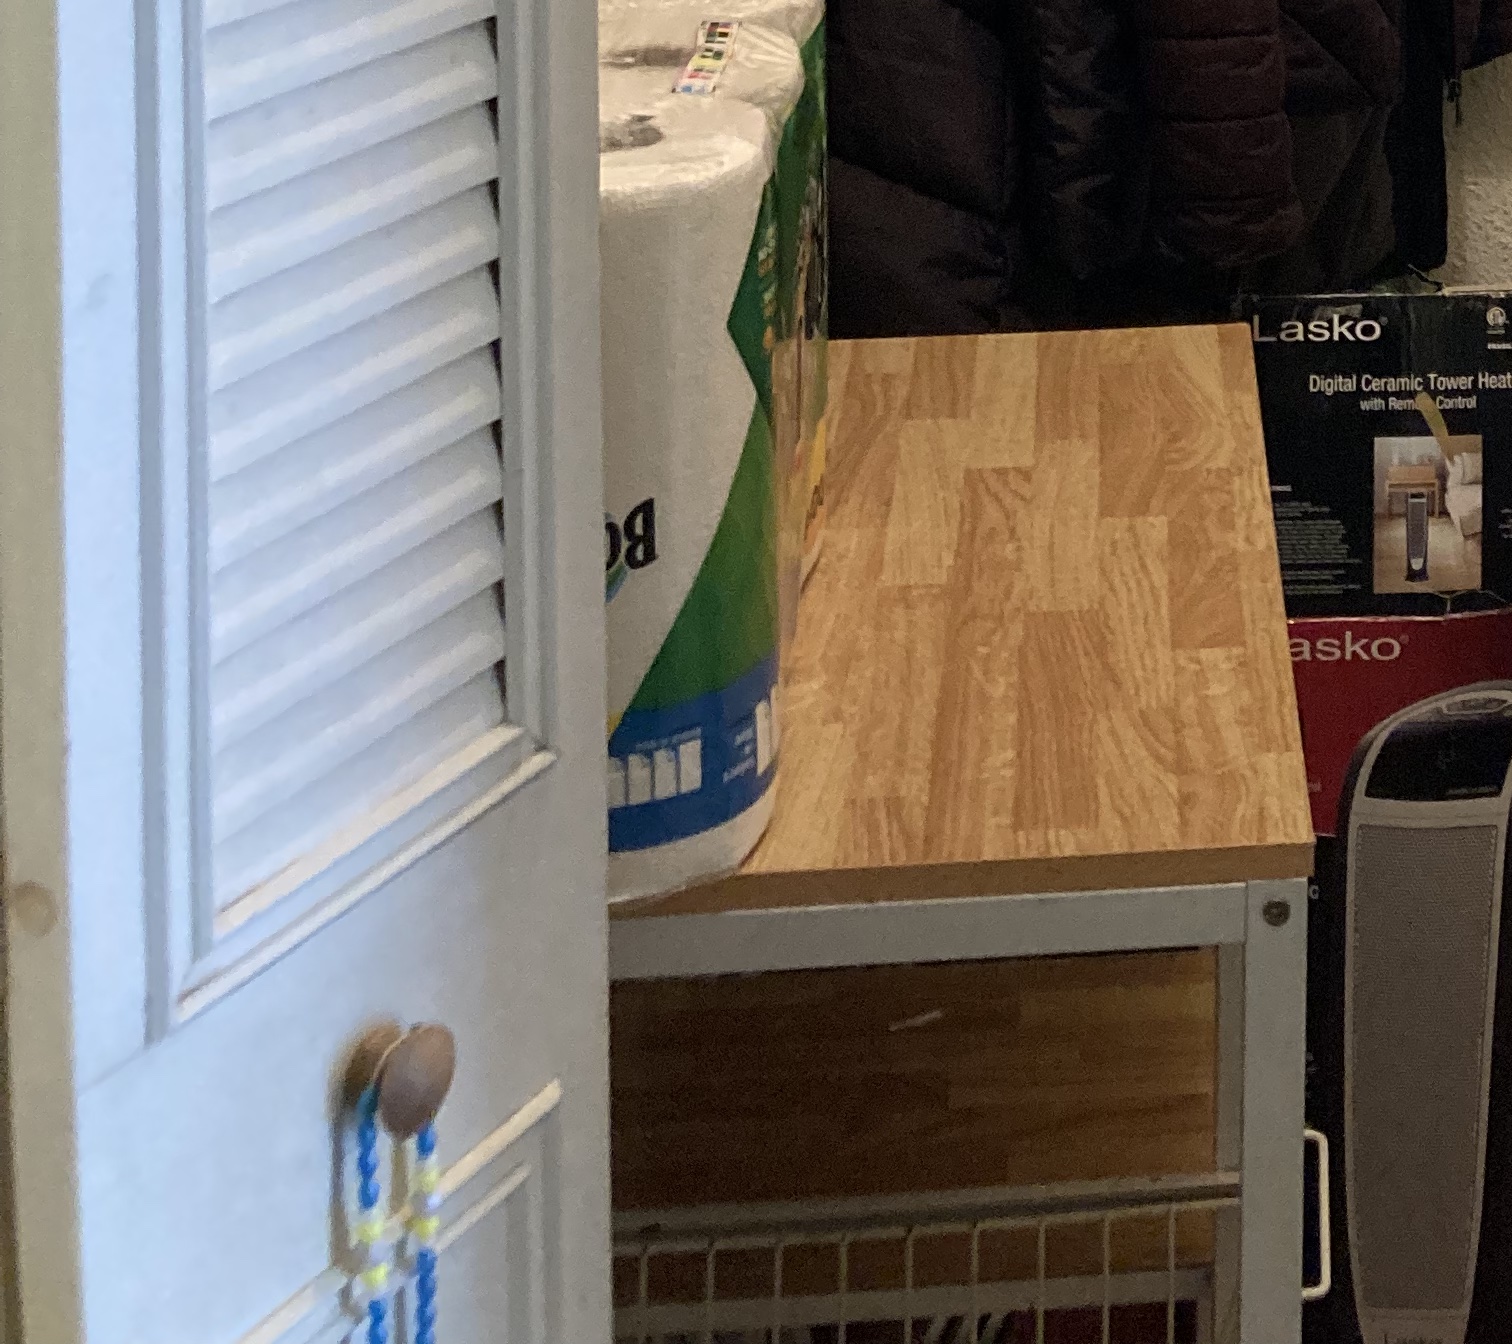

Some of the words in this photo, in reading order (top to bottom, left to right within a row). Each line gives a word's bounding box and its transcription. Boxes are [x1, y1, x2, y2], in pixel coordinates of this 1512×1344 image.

[1252, 313, 1381, 342] Lasko
[1309, 374, 1357, 396] Digital
[1361, 374, 1424, 393] Ceramic
[1427, 373, 1474, 391] Tower
[1360, 398, 1385, 411] with
[1435, 395, 1477, 410] Control
